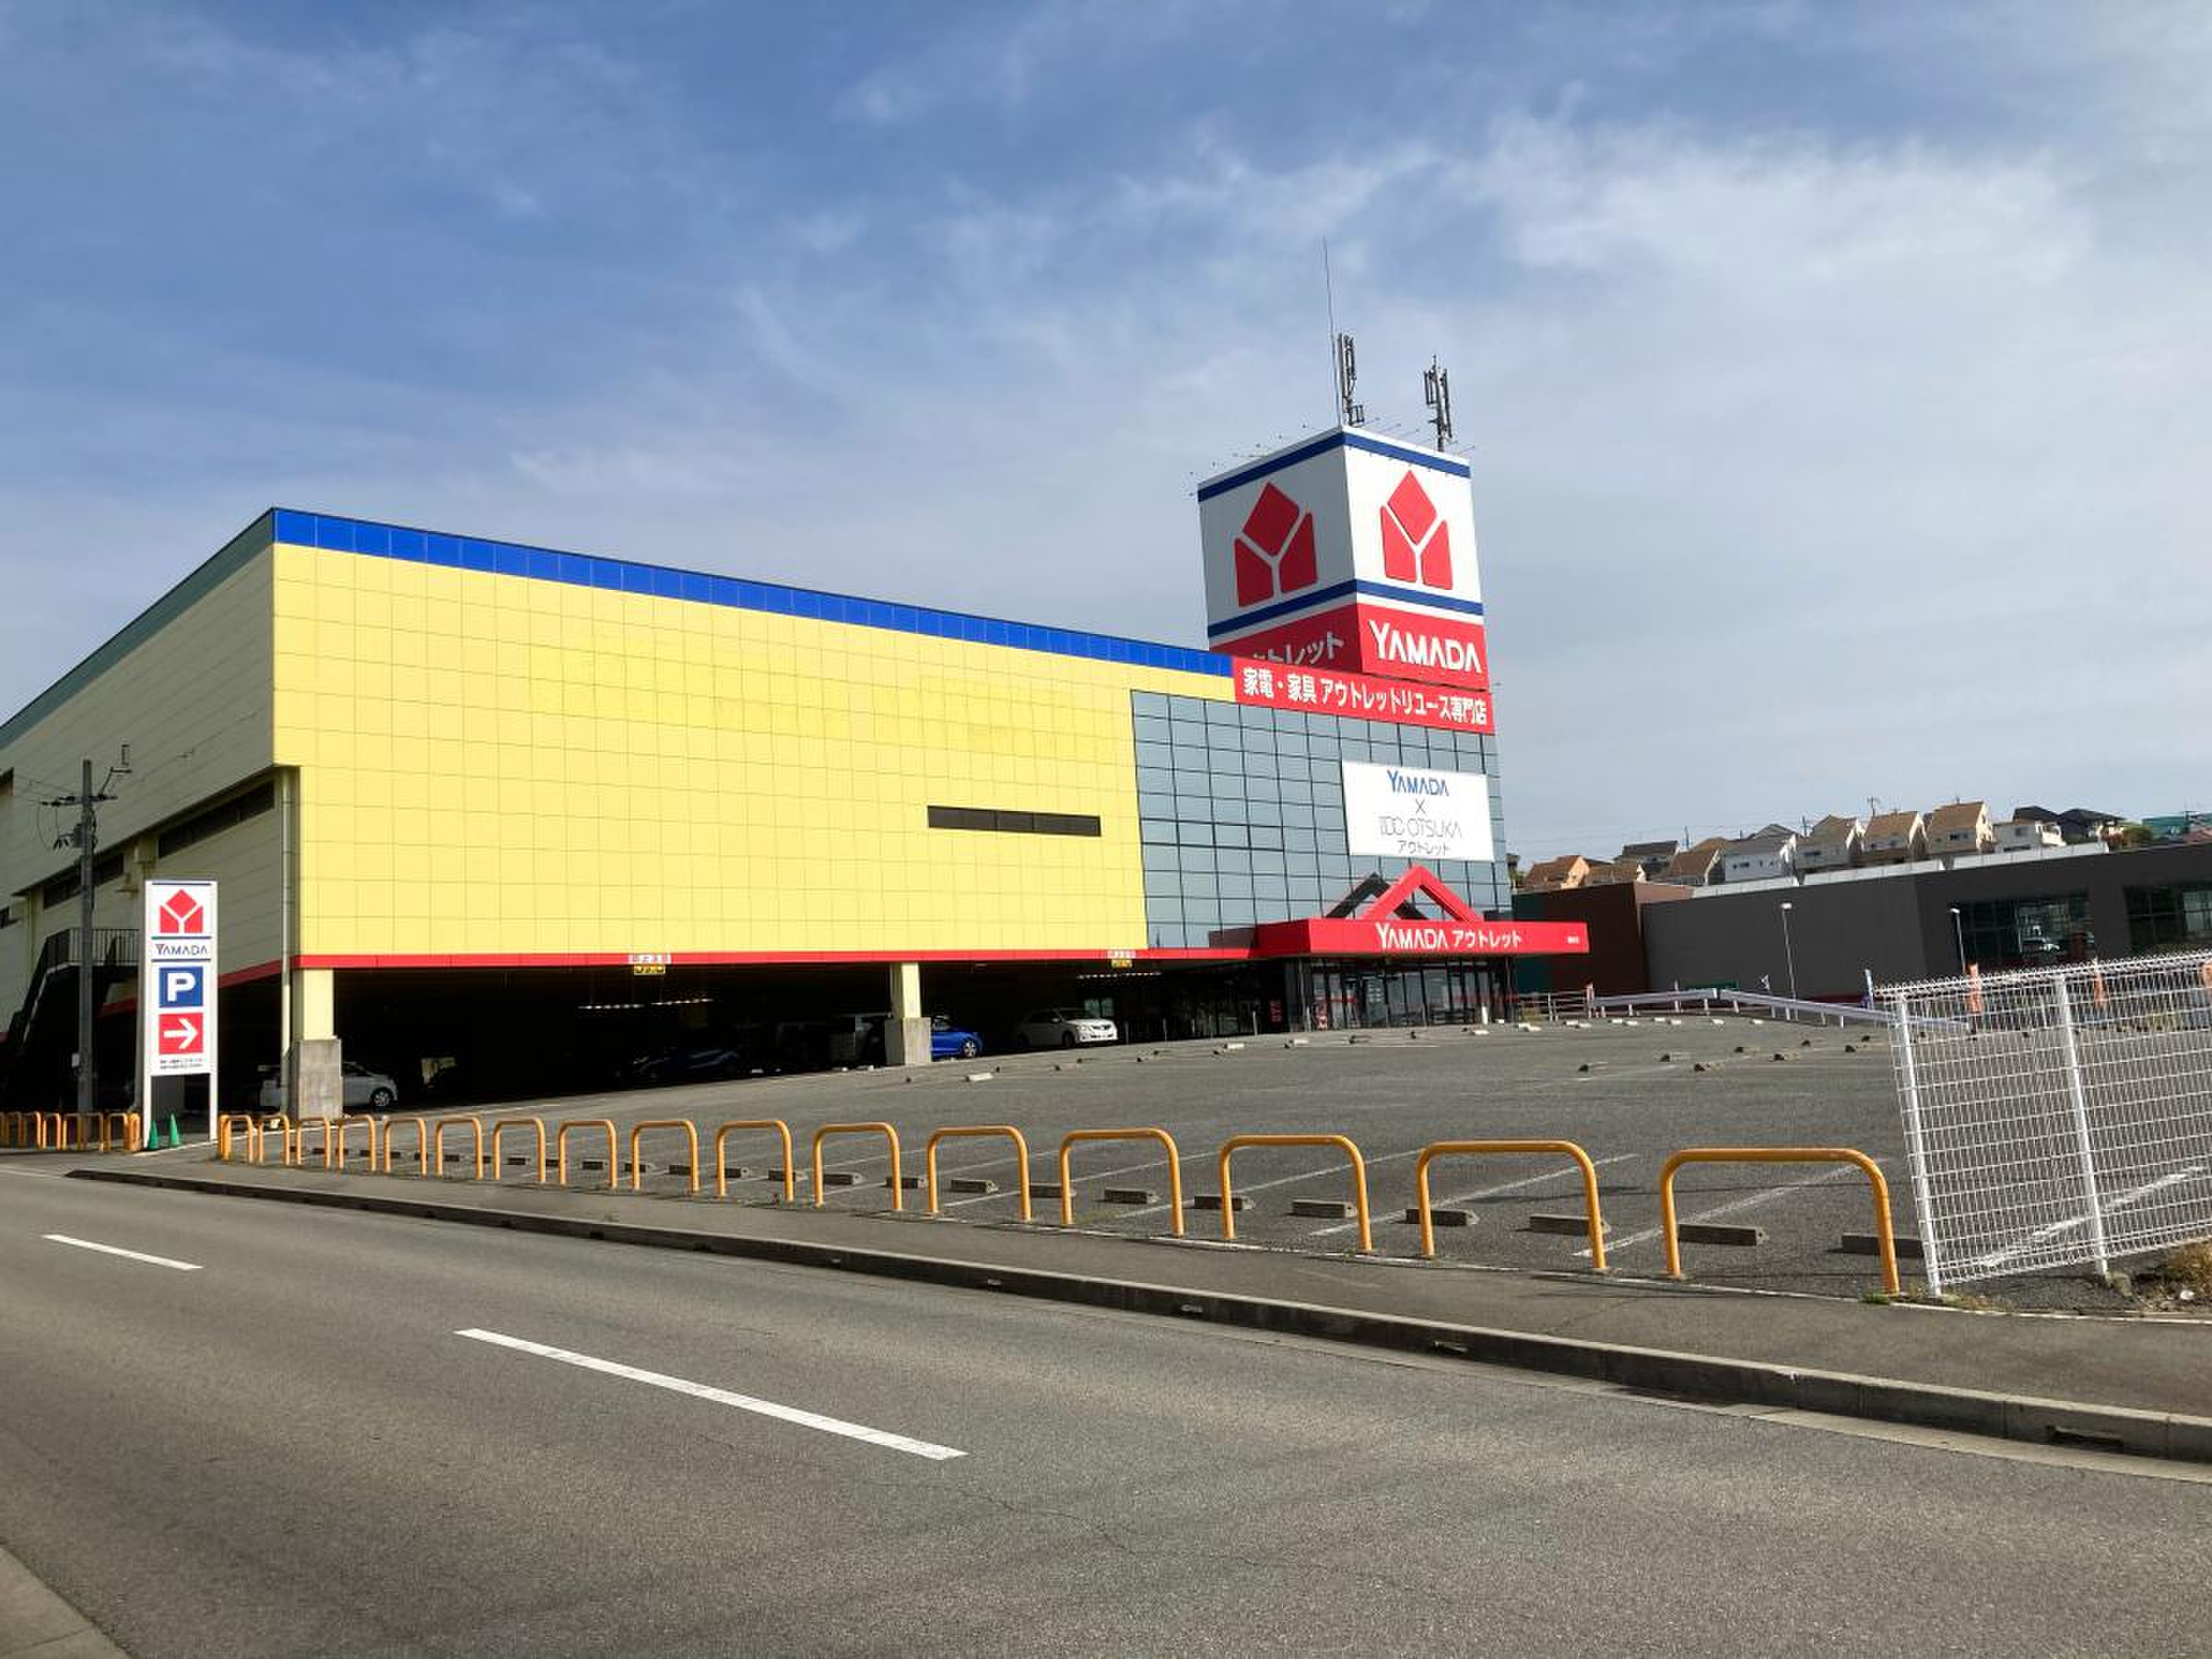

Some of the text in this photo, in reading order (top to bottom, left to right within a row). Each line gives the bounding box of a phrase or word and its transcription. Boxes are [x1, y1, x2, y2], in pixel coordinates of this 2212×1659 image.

[1253, 630, 1345, 665] トレット
[1369, 618, 1483, 674] YAMADA
[1243, 667, 1488, 725] 家電・家具 アウトレットリユース専門店
[1387, 770, 1450, 797] YAMADA
[1406, 818, 1465, 840] OTSUKA
[1397, 840, 1452, 856] アウトレット
[155, 943, 208, 956] YAMADA
[1375, 922, 1523, 950] YAMADA アウトレット
[167, 972, 196, 1002] P
